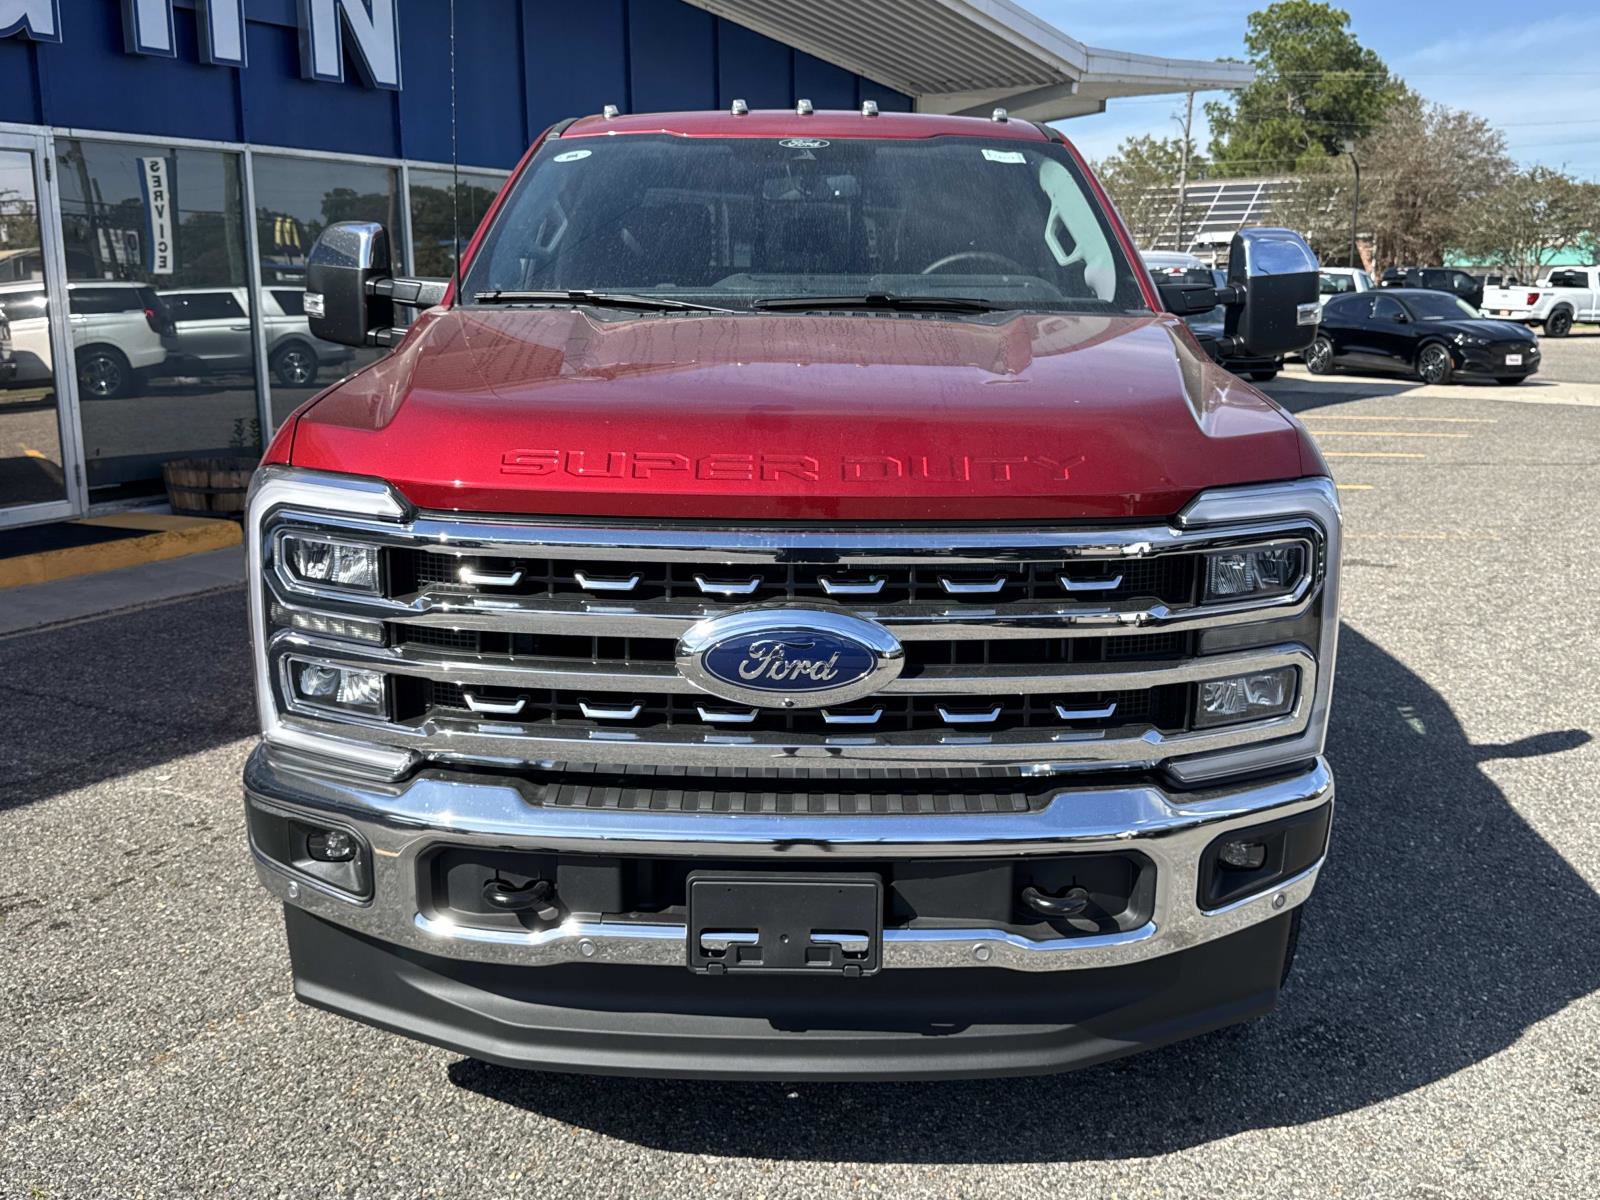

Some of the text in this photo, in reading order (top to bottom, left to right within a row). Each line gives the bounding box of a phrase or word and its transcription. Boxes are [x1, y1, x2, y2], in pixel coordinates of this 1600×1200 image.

[500, 449, 1086, 482] SUPER DUTY
[738, 639, 842, 681] Ford
